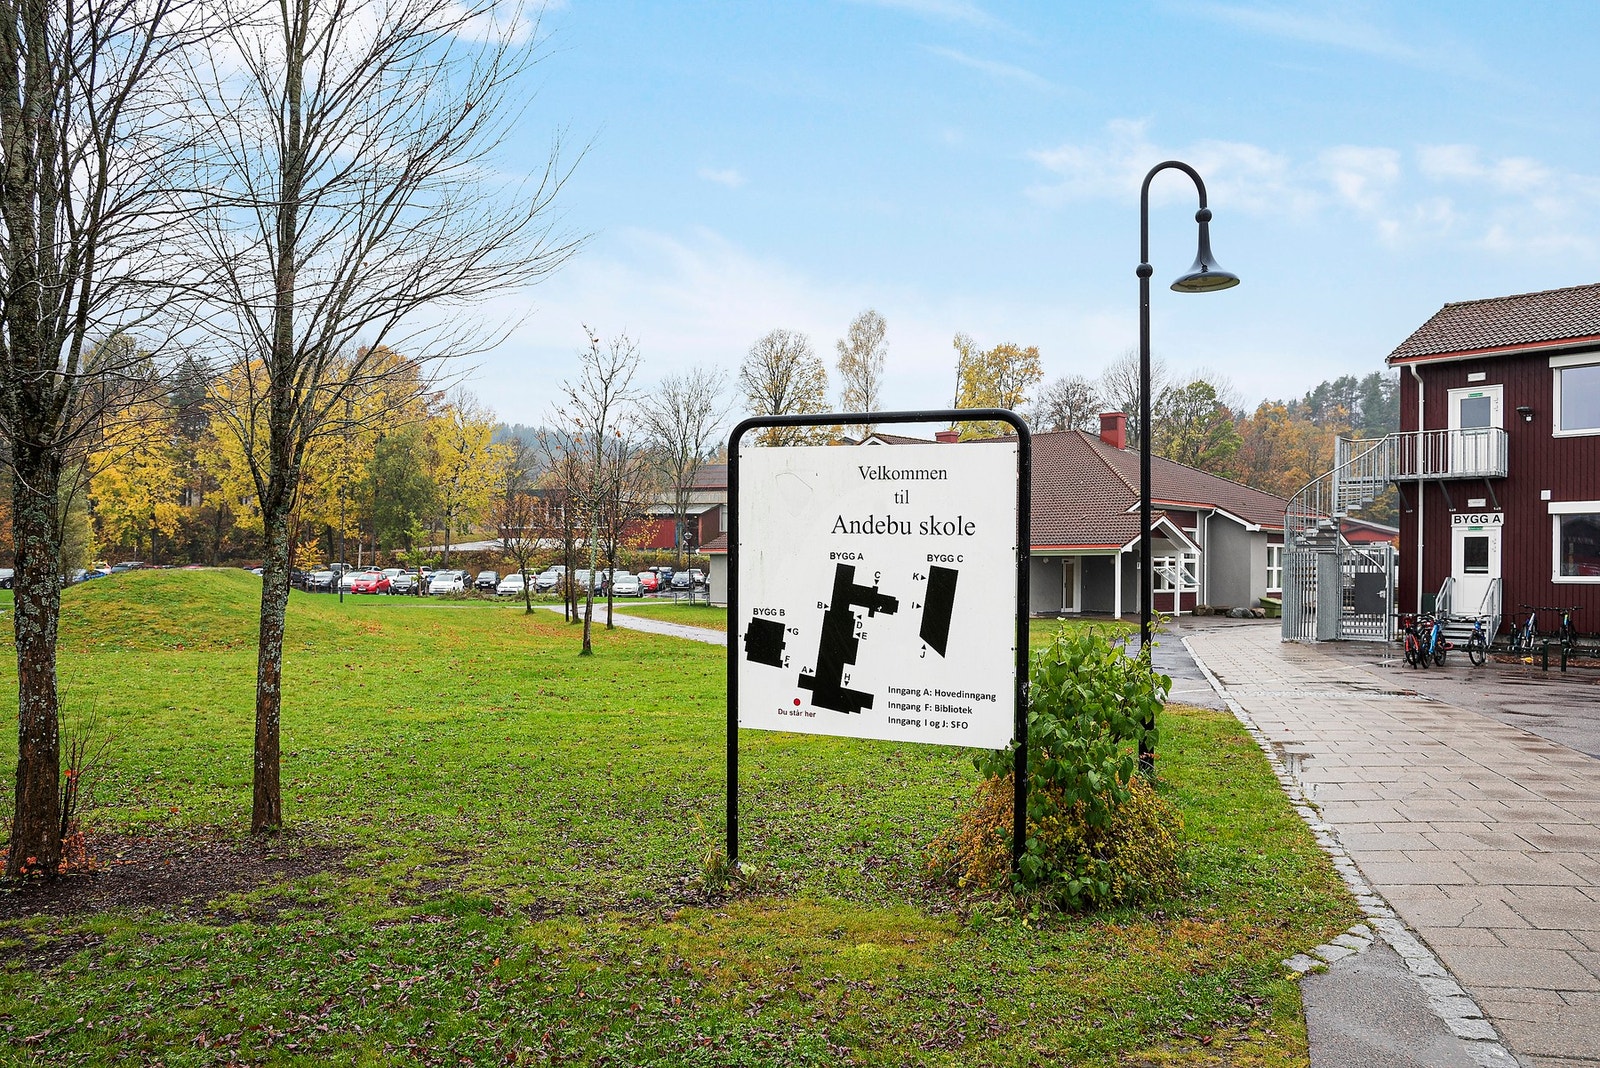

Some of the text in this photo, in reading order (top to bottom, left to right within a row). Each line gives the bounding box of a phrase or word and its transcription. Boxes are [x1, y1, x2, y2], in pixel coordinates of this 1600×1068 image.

[858, 465, 948, 481] Velkommen
[894, 489, 910, 505] til
[1454, 514, 1501, 524] BYGG A
[831, 515, 976, 536] Andebu skole
[829, 552, 864, 561] BYGG A
[926, 554, 964, 563] BYGG C
[874, 571, 881, 579] C
[912, 572, 920, 581] K
[816, 601, 824, 610] B
[752, 607, 786, 617] BYGG B
[856, 621, 863, 629] D
[792, 627, 799, 636] G
[861, 631, 868, 640] E
[784, 655, 791, 663] F
[919, 650, 926, 659] J
[801, 666, 808, 674] A
[843, 672, 851, 681] H
[888, 686, 997, 702] Inngang A: Hovedinngang
[888, 701, 973, 715] Inngang F: Bibliotek
[777, 708, 817, 718] Du står her
[888, 716, 922, 728] Inngang
[929, 720, 941, 730] og
[941, 719, 949, 728] J:
[950, 720, 969, 730] SFO
